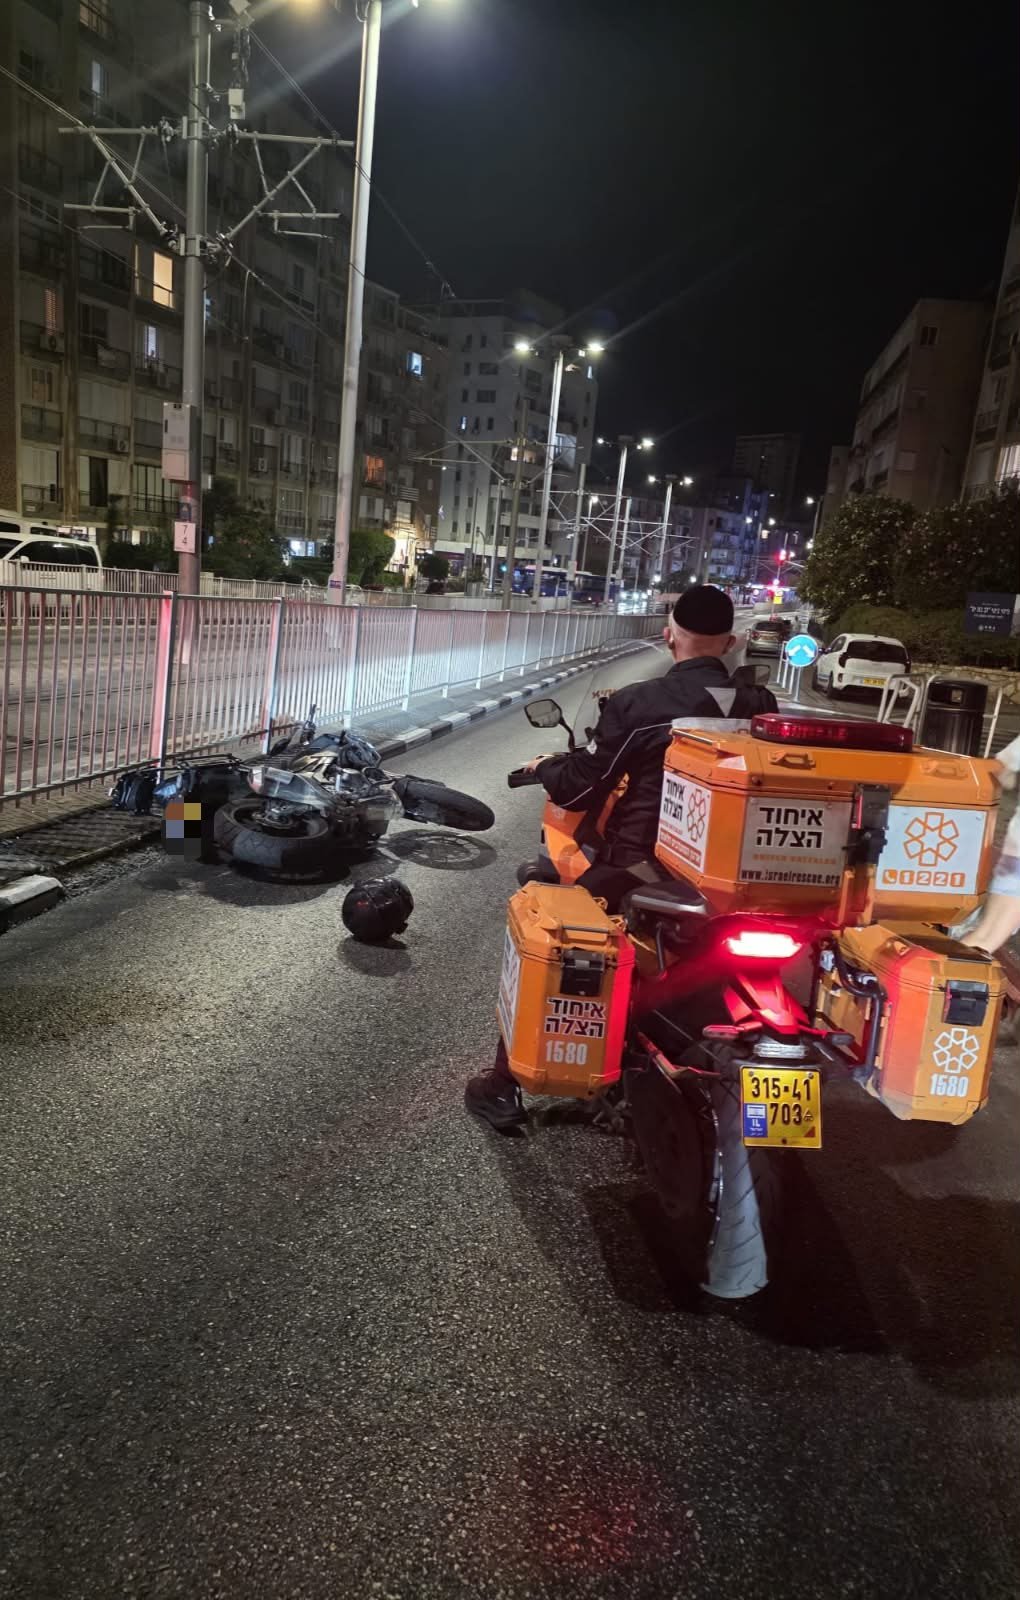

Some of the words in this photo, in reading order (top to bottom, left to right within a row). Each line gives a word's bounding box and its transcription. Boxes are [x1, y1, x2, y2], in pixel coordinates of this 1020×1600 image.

[666, 779, 685, 801] איחוד
[663, 797, 683, 822] הצלה
[759, 807, 824, 826] איחוד
[756, 827, 823, 849] הצלה
[900, 870, 965, 887] 1221
[548, 998, 605, 1018] איחוד
[545, 1017, 604, 1038] הצלה
[546, 1040, 588, 1065] 1580
[930, 1073, 969, 1097] 1580
[770, 1103, 802, 1126] 703
